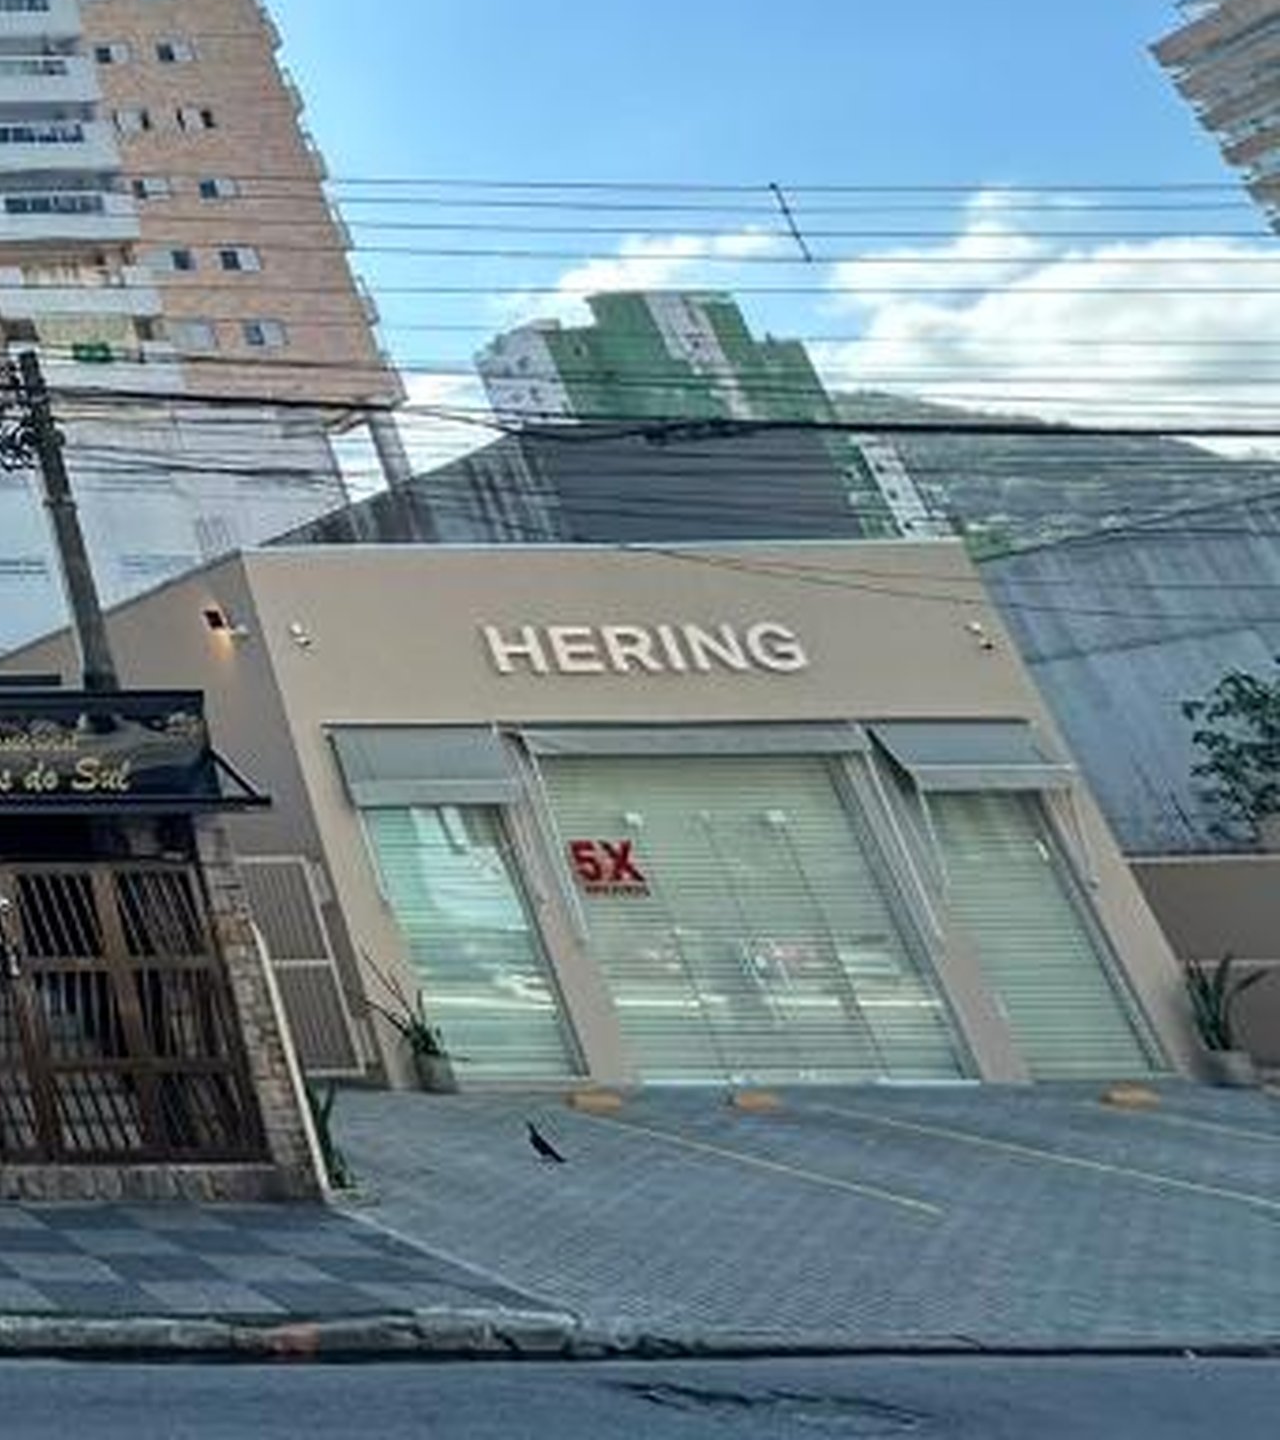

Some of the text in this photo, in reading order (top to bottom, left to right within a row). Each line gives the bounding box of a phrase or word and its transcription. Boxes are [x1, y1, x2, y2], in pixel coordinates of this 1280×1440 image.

[483, 622, 810, 674] HERING
[23, 760, 58, 792] do
[71, 757, 131, 792] Sul
[569, 838, 645, 882] 5X
